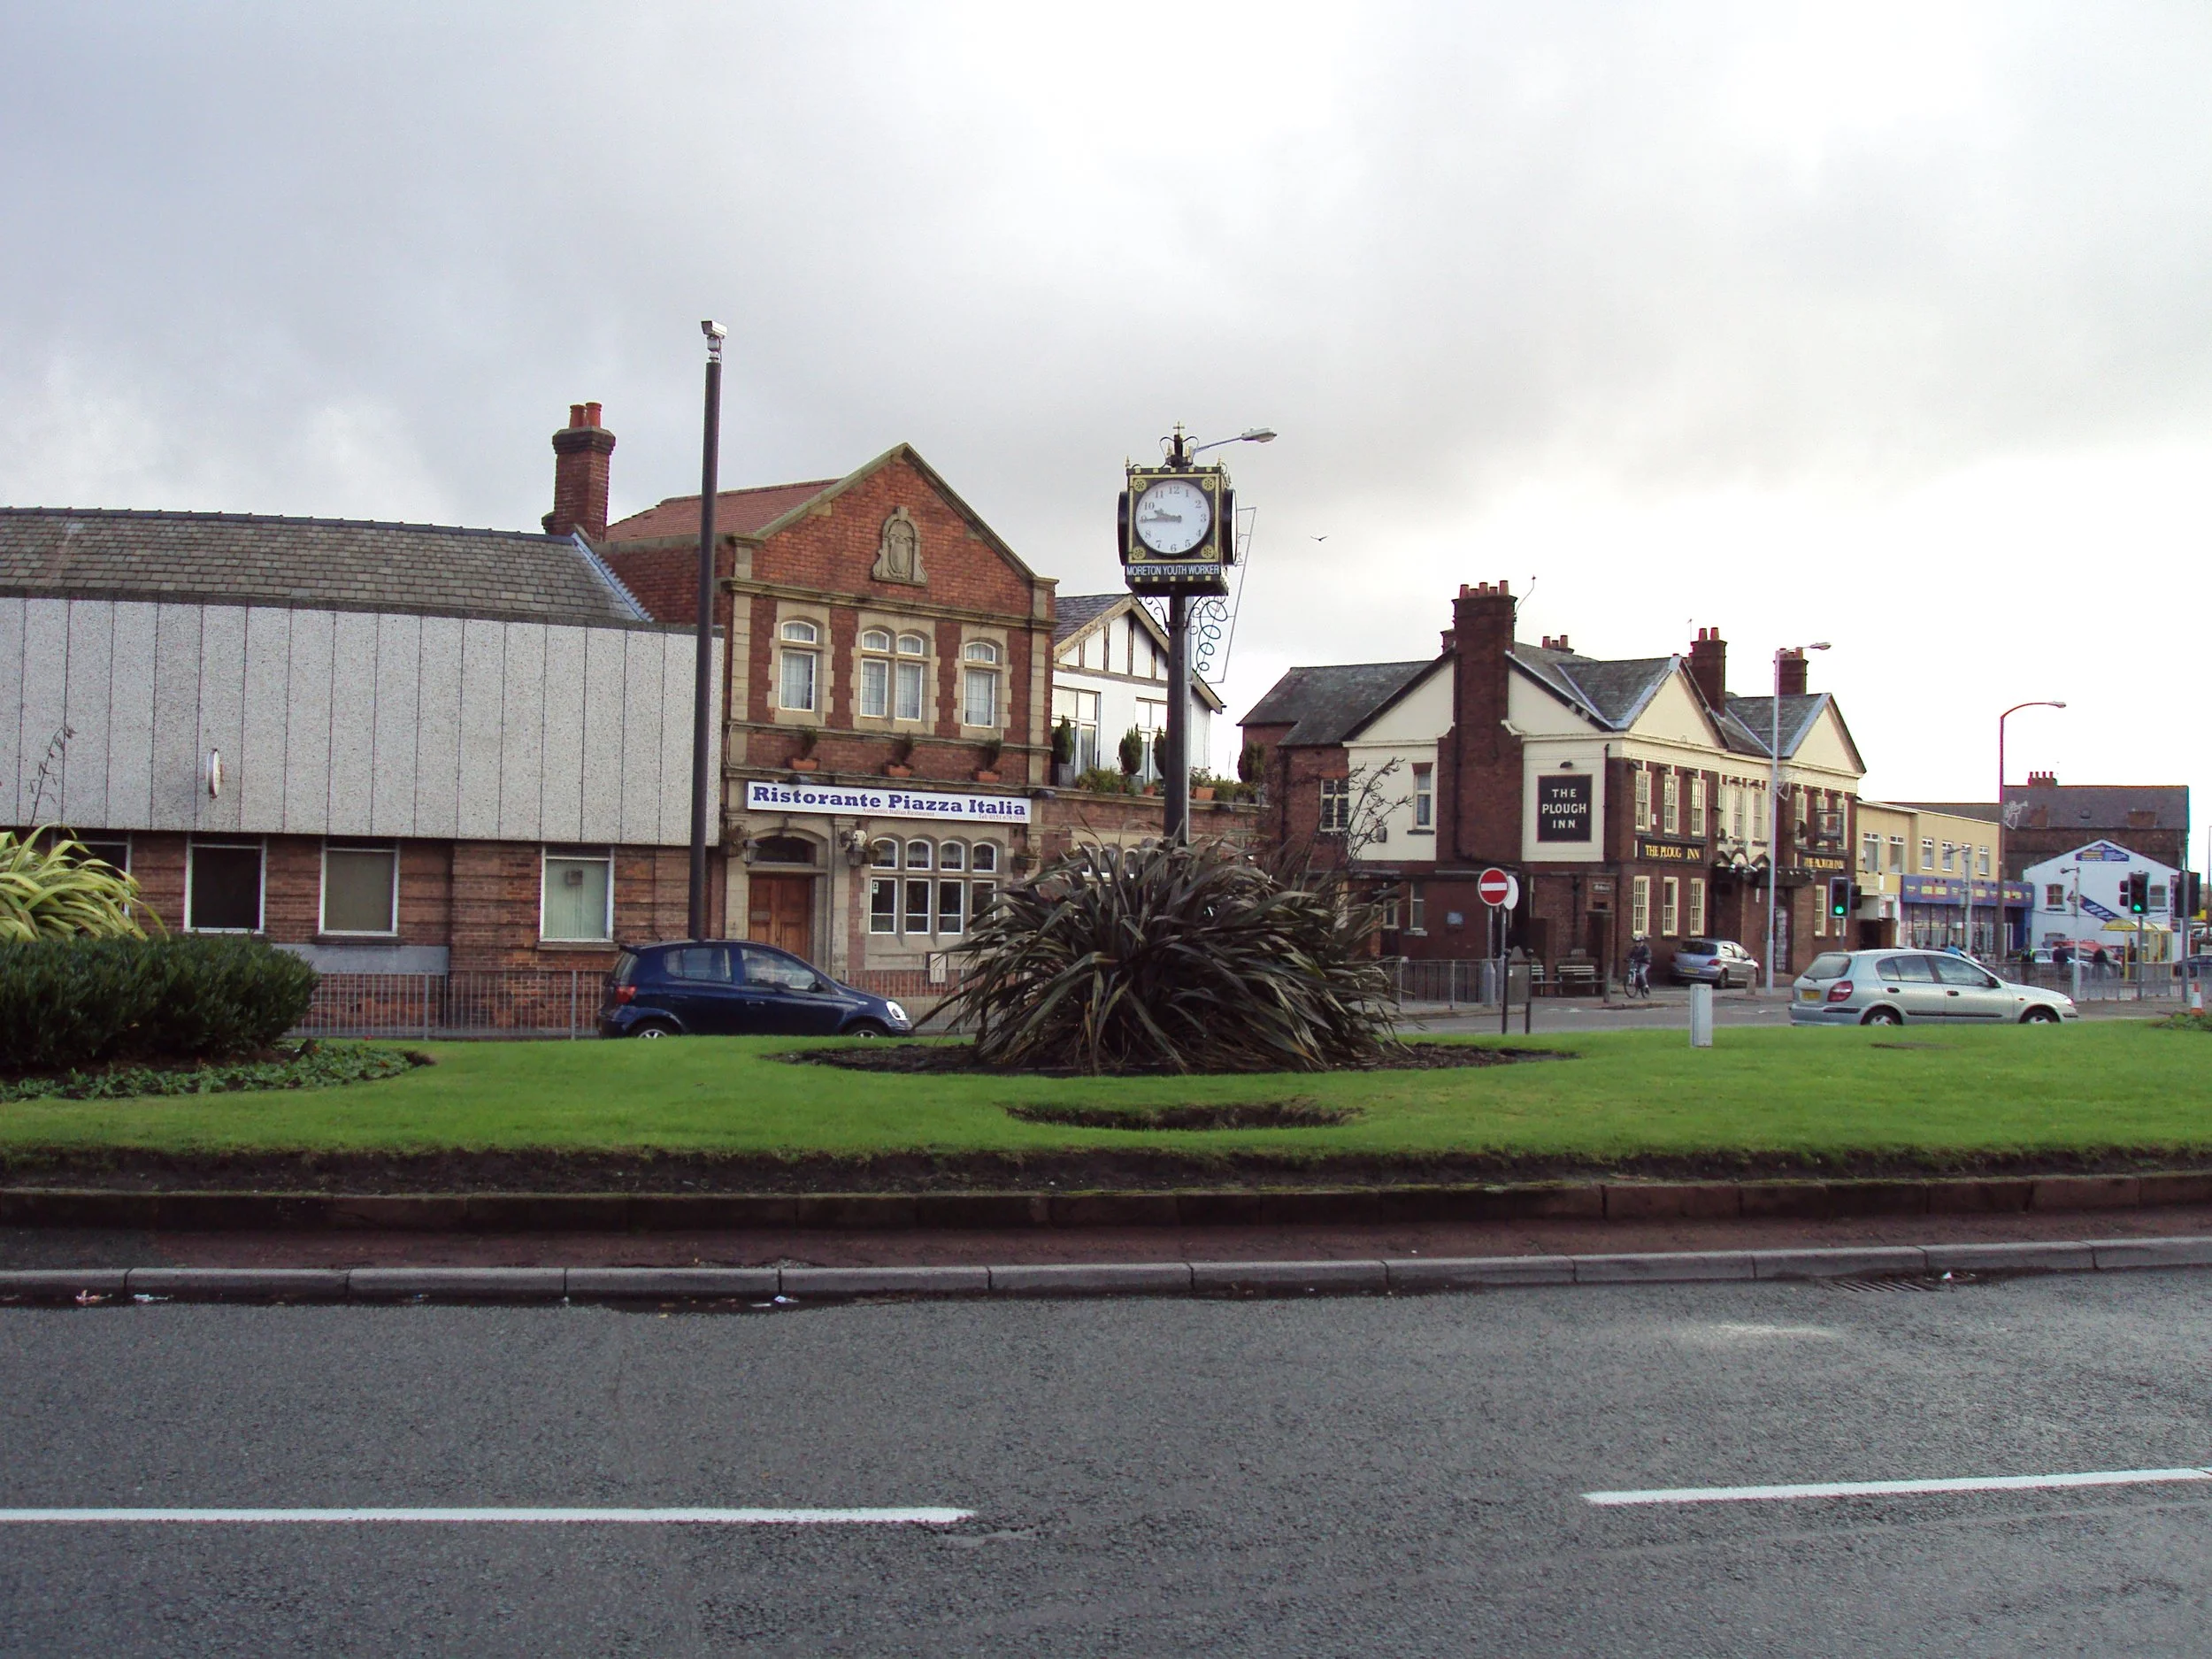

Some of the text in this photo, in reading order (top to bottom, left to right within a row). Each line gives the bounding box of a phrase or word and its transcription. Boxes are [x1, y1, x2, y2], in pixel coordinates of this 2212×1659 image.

[1168, 485, 1179, 495] 12
[1186, 488, 1189, 497] 1
[1144, 502, 1155, 511] 10
[1195, 500, 1202, 509] 2
[1200, 513, 1207, 523] 3
[1146, 530, 1152, 539] 8
[1156, 540, 1162, 549] 7
[1171, 543, 1177, 553] 6
[1185, 539, 1191, 548] 5
[1126, 565, 1220, 576] MORETON YOUTH WORKER
[1551, 788, 1577, 798] THE
[753, 786, 1026, 816] Ristorante Piazza Italia
[1542, 803, 1586, 814] PLOUGH
[1553, 819, 1576, 829] INN
[1645, 844, 1659, 856] THE
[1686, 848, 1700, 860] INN
